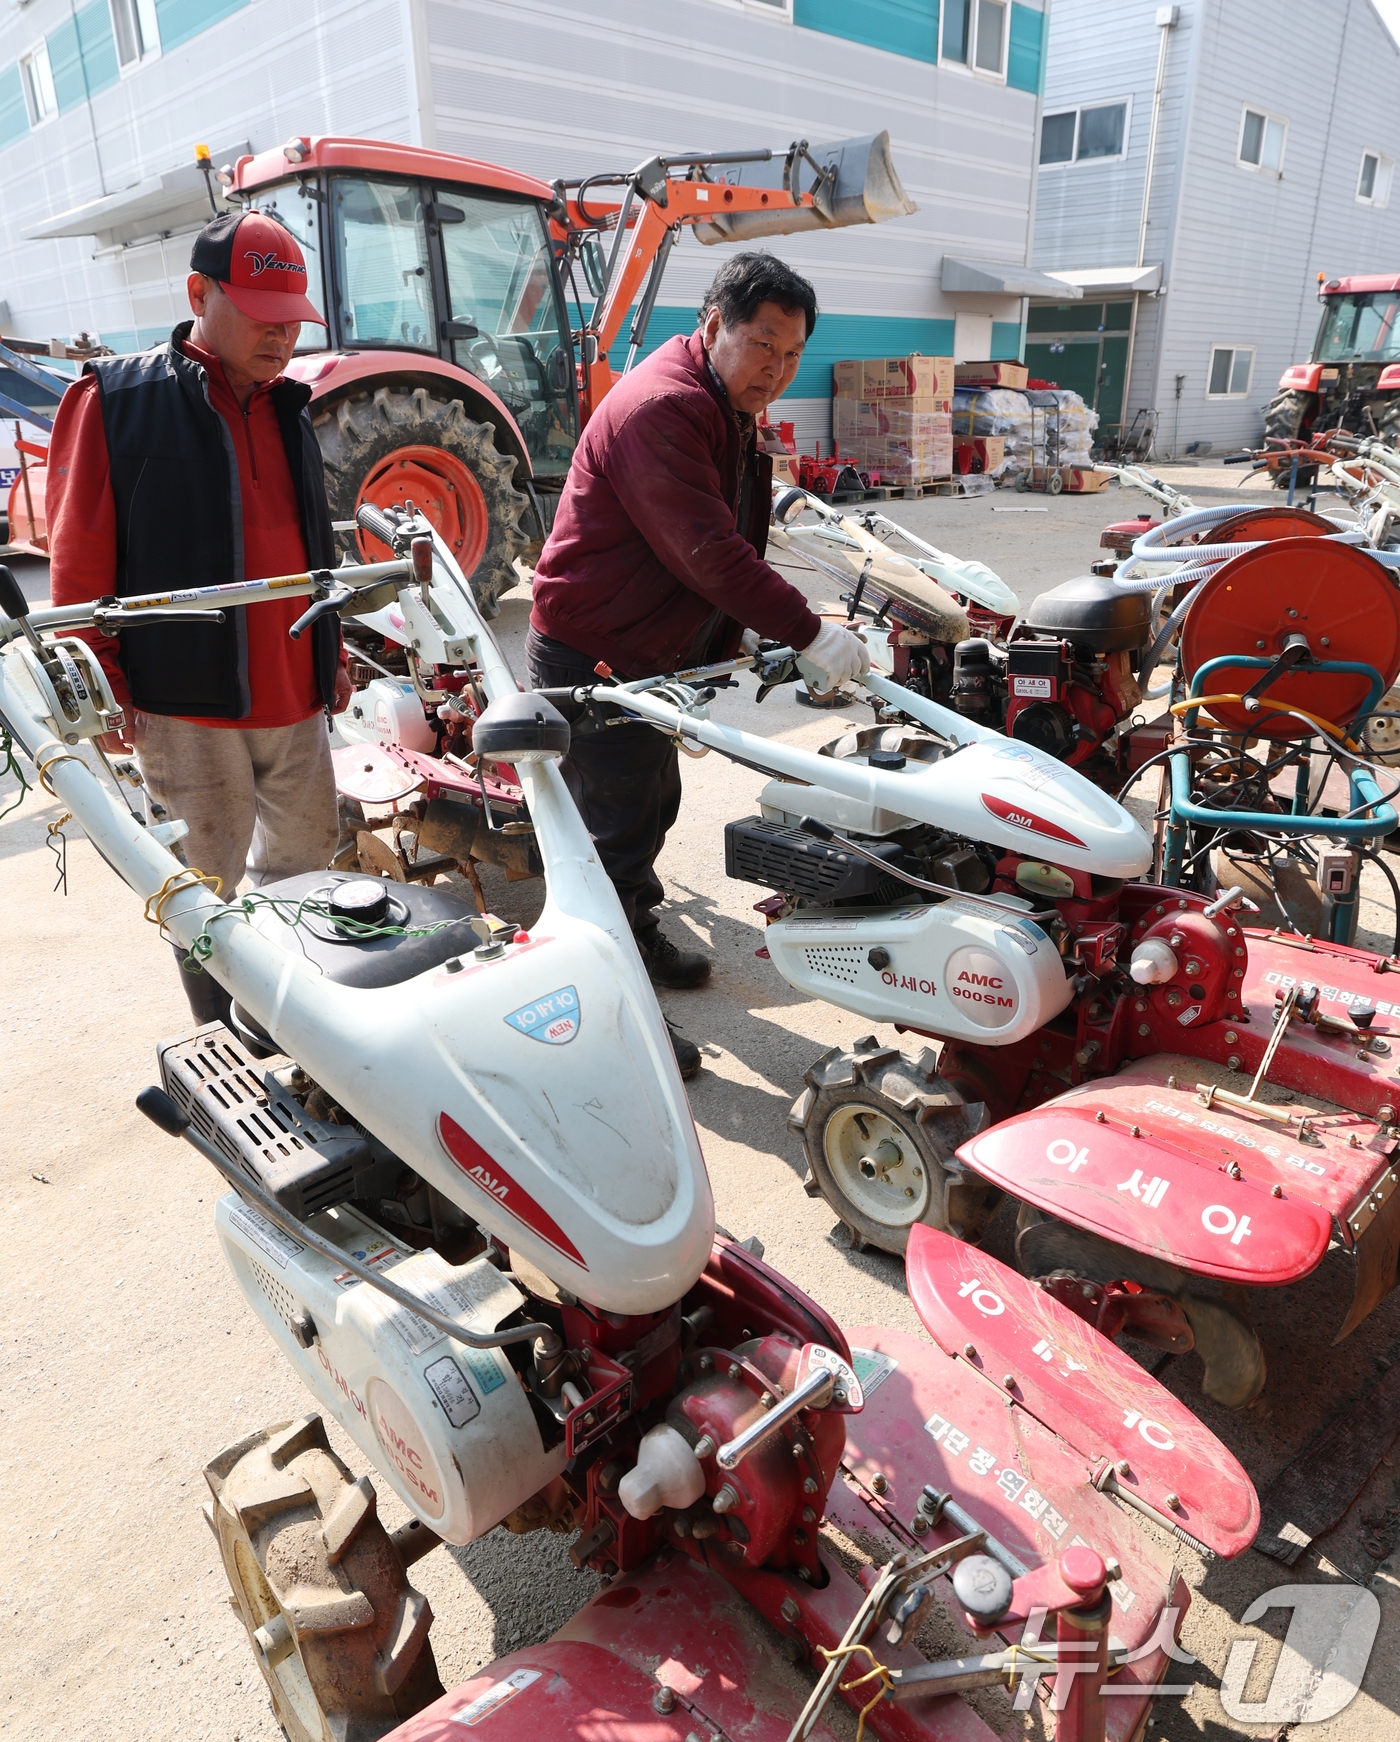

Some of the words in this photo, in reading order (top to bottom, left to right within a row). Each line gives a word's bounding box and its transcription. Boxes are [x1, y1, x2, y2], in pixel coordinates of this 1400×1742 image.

[1006, 812, 1033, 827] ASIA
[881, 971, 937, 996] 아세아
[957, 971, 1003, 989] AMC
[515, 992, 574, 1029] 아세아
[952, 987, 1013, 1008] 900SM
[549, 1020, 574, 1039] NEW
[469, 1165, 510, 1199] ASIA
[317, 1348, 367, 1422] 아세아
[379, 1415, 423, 1470] AMC
[923, 1412, 972, 1457] 다단
